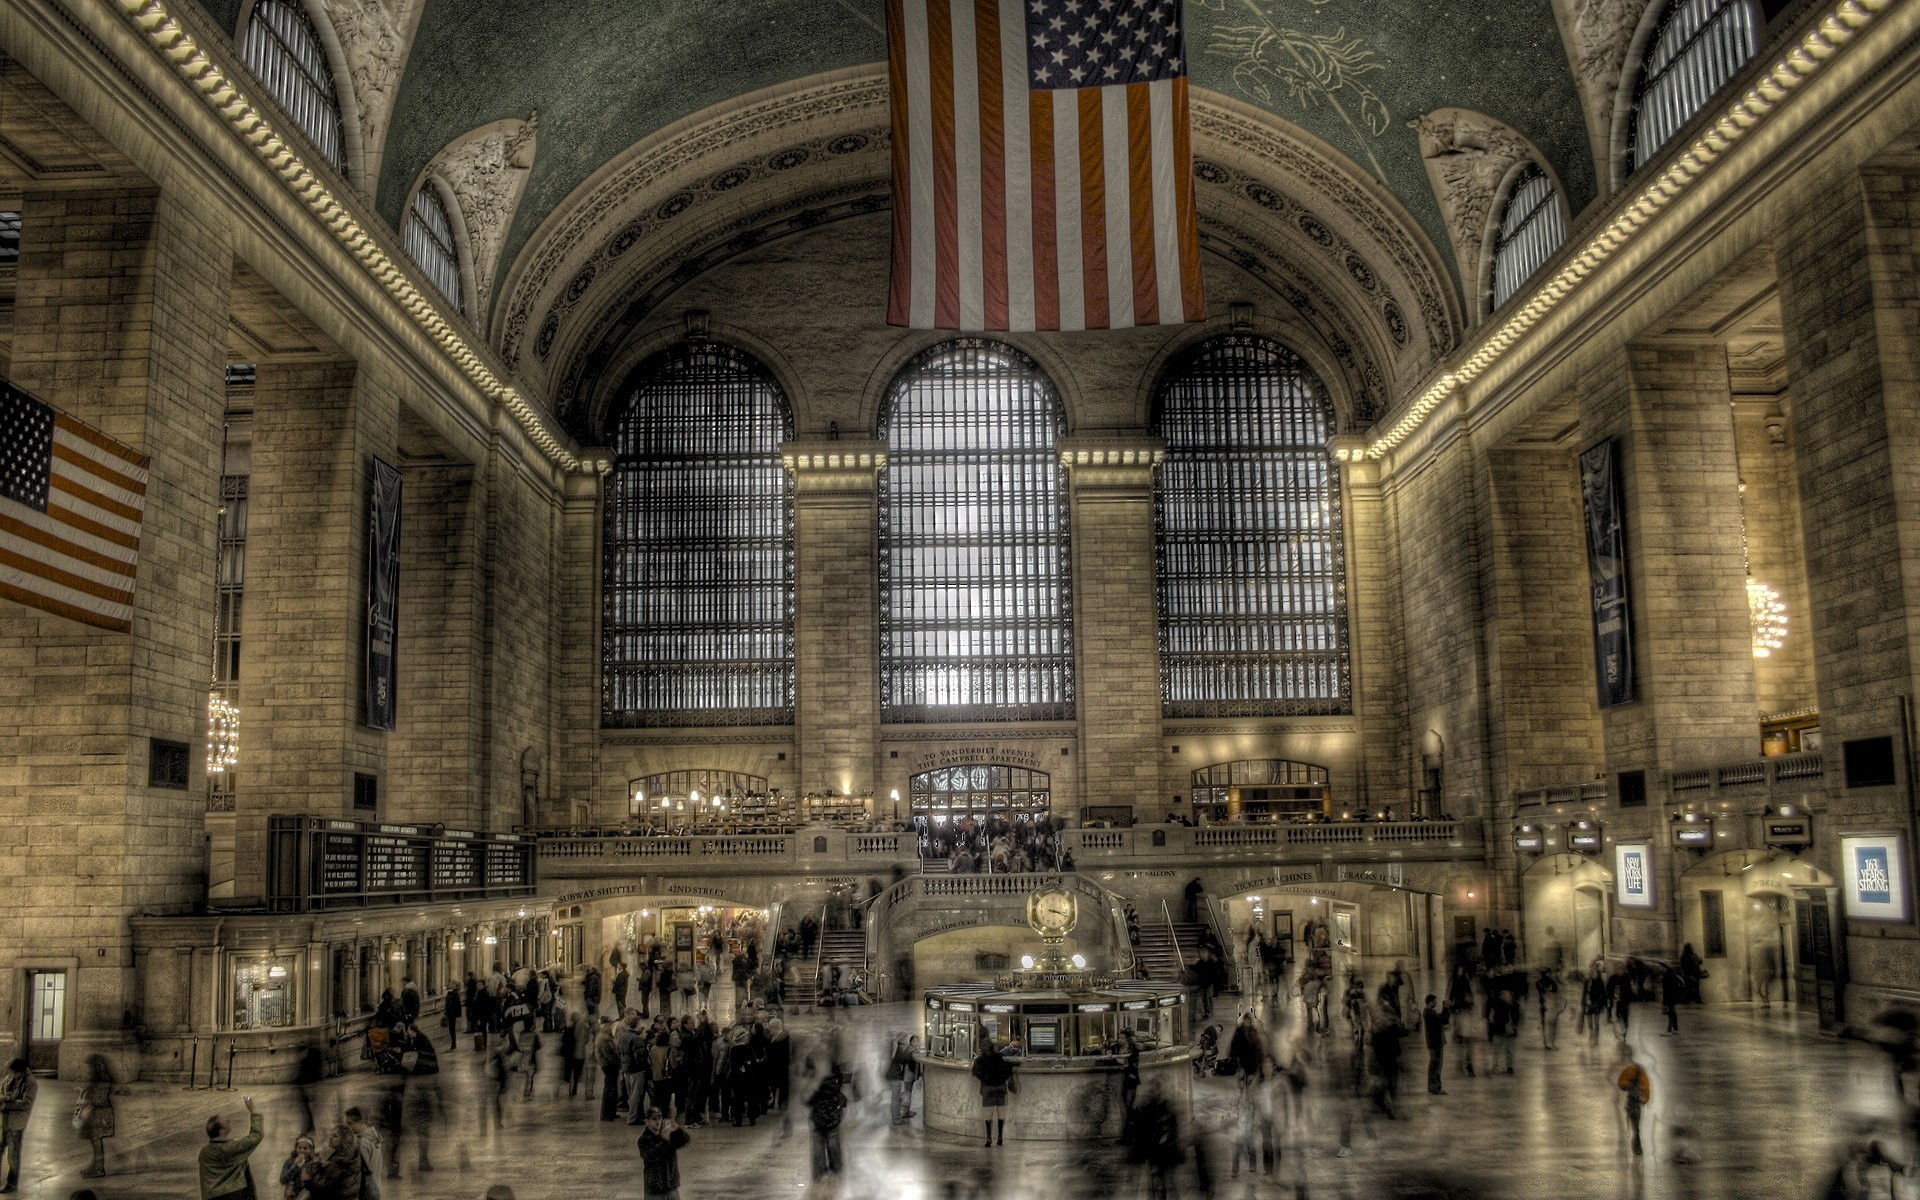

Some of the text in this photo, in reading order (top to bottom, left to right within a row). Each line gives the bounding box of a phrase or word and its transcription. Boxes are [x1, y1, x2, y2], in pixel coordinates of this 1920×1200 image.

[923, 747, 1036, 761] TO VANDERBILT AVENUE
[918, 755, 1042, 770] THE CAMPBELL APARTMENT
[1626, 857, 1640, 869] NEW
[1864, 858, 1878, 870] 163
[1343, 872, 1377, 881] TRACKS
[1625, 867, 1641, 879] YORK
[1860, 869, 1884, 881] YEARS
[1234, 872, 1312, 891] TICKET MCHINES
[1627, 877, 1641, 889] LIFE
[1858, 879, 1889, 892] STRONG
[558, 885, 637, 903] SUBWAY SHUTTLE
[668, 885, 726, 897] 42ND STREET
[647, 898, 678, 907] SUBWAY
[918, 926, 941, 938] DINING
